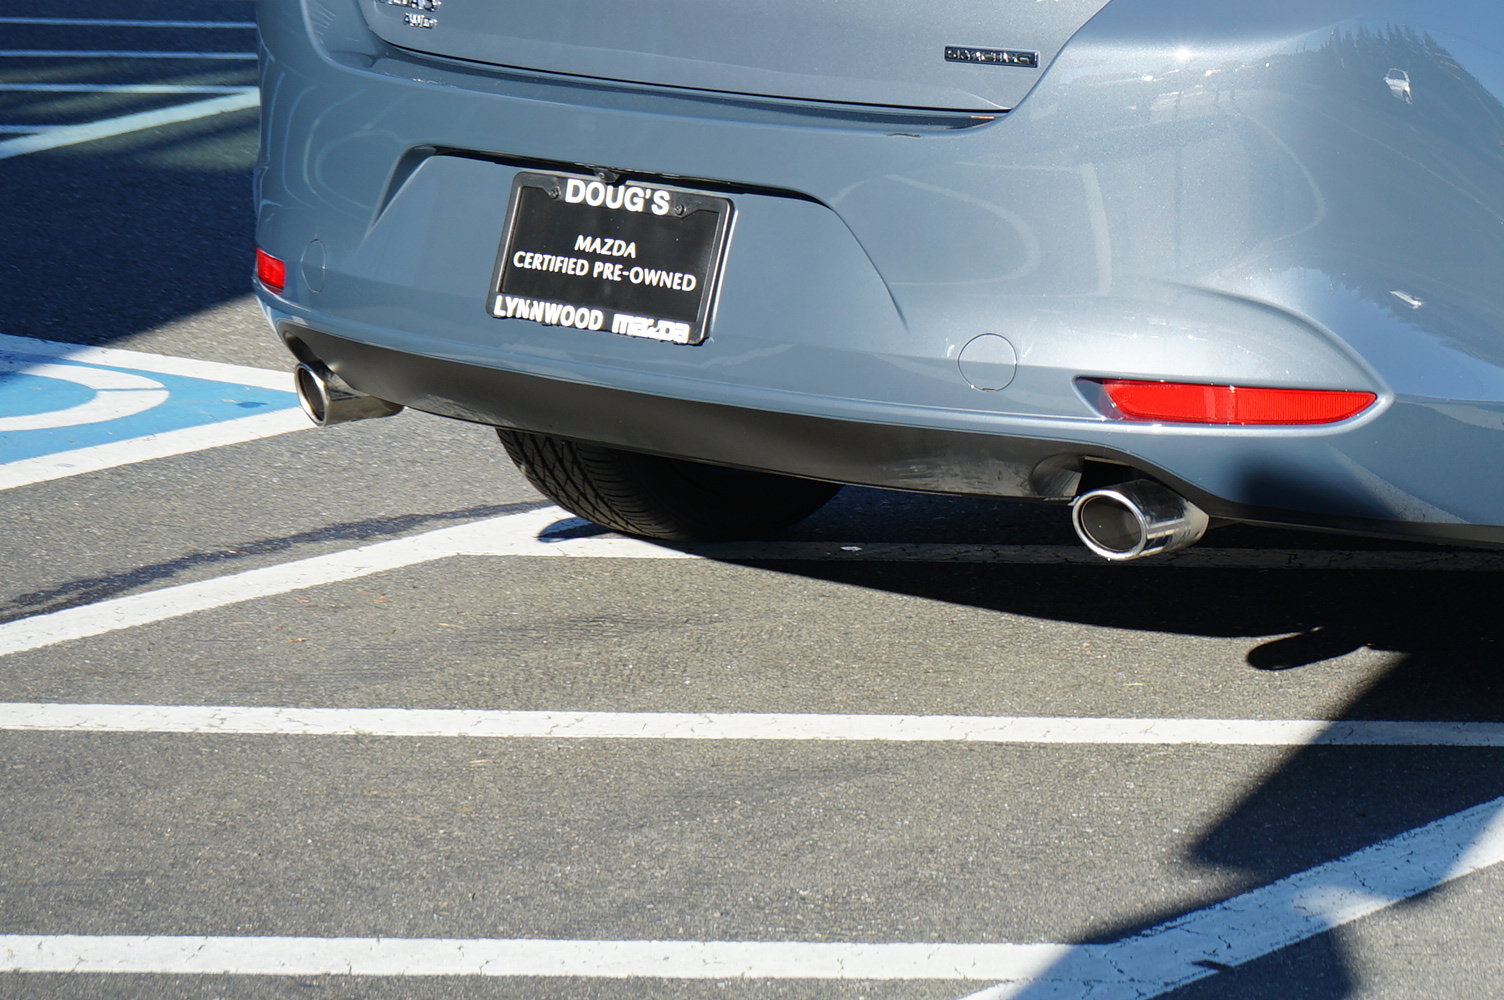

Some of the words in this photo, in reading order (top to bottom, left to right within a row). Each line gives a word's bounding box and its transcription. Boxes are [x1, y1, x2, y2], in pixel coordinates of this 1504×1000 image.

[565, 178, 671, 216] DOUG'S
[574, 234, 637, 259] MAZDA
[513, 251, 589, 276] CERTIFIED
[593, 261, 697, 292] PRE-OWNED
[493, 295, 604, 331] LYNNWOOD
